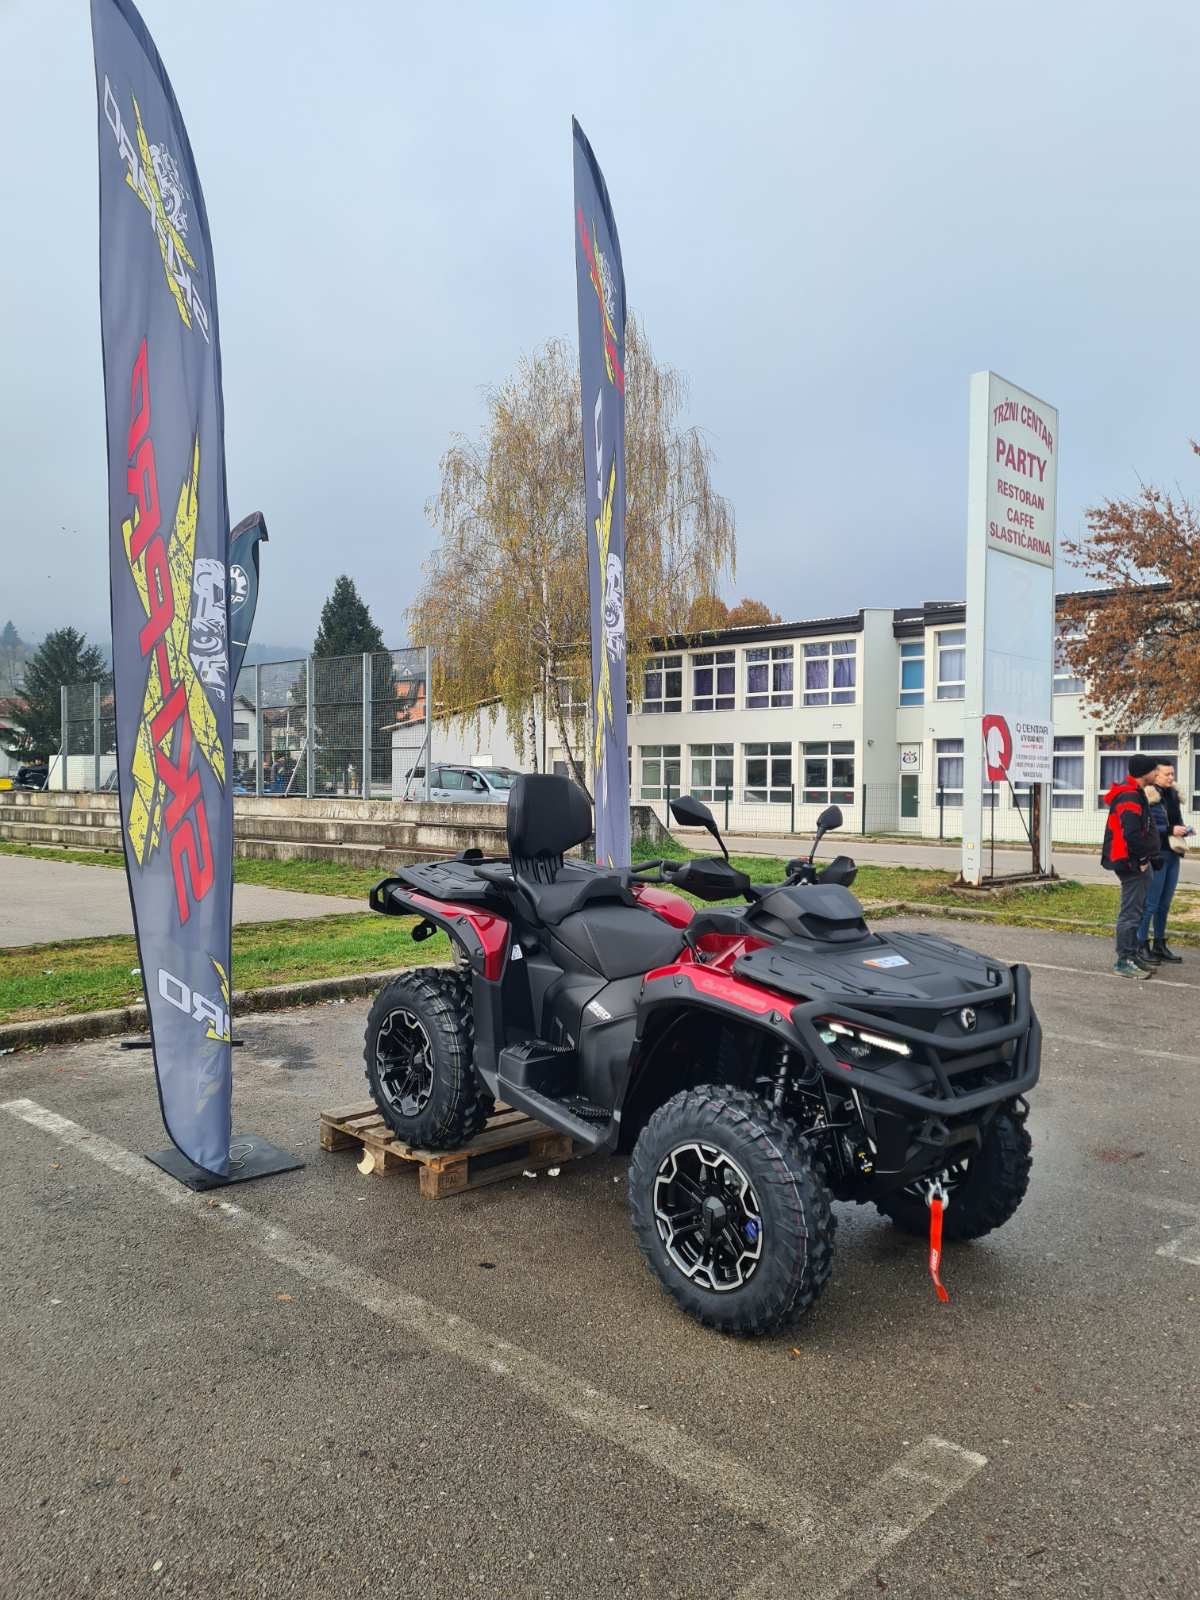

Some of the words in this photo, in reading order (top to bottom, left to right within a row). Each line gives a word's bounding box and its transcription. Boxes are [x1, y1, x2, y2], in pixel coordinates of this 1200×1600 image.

[994, 397, 1019, 427] TRŽNI
[1021, 404, 1054, 455] CENTAR
[996, 437, 1047, 482] PARTY
[997, 479, 1045, 511] RESTORAN
[1007, 507, 1035, 530] CAFFE
[990, 521, 1052, 557] SLASTIČARNA
